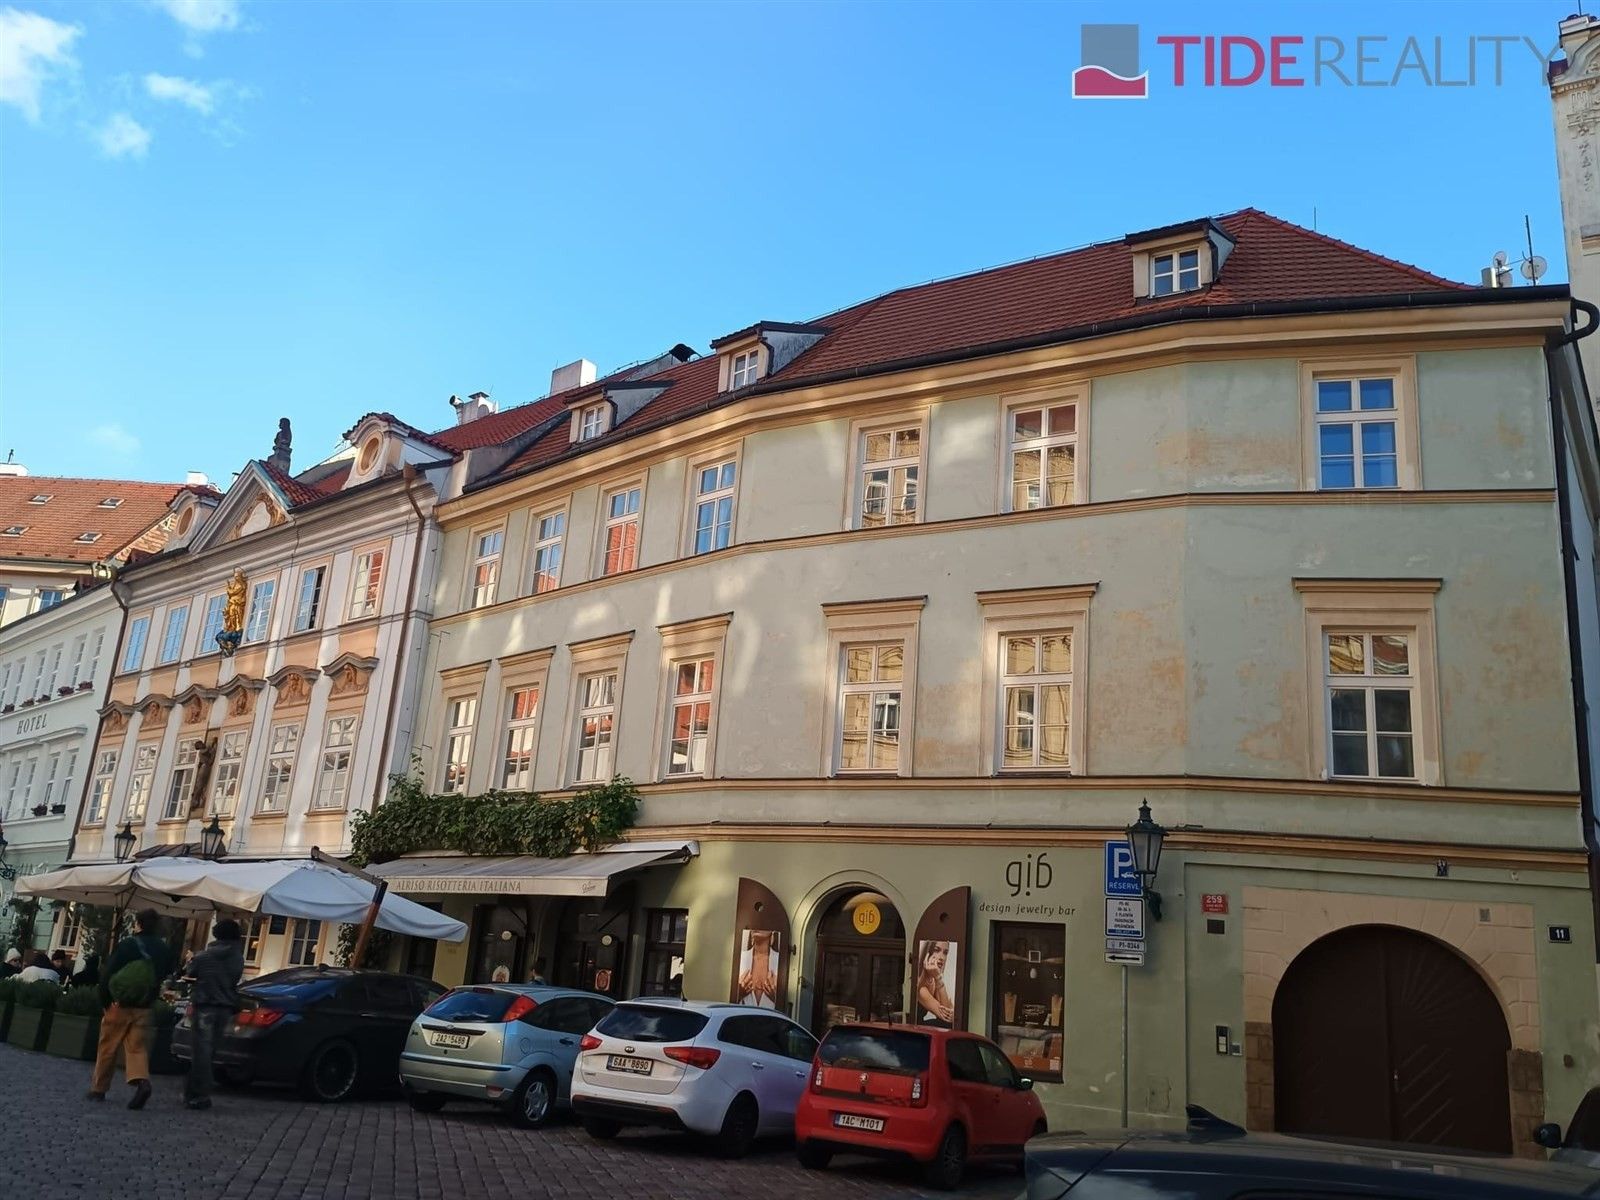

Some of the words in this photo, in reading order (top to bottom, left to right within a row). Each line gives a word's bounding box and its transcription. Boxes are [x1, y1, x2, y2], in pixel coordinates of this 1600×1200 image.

[17, 713, 47, 735] HOTEL
[1113, 847, 1133, 879] P
[1006, 852, 1053, 898] gib
[427, 880, 477, 892] RISOTTERIA
[479, 880, 521, 892] ITALIANA
[1206, 895, 1223, 904] 259
[979, 902, 1011, 914] design
[1016, 904, 1054, 917] jewelry
[1058, 906, 1076, 916] bar
[859, 910, 875, 926] gib
[1555, 929, 1564, 939] 11
[613, 1057, 627, 1068] 6AA
[842, 1115, 856, 1126] 1AC
[860, 1118, 880, 1130] M101
